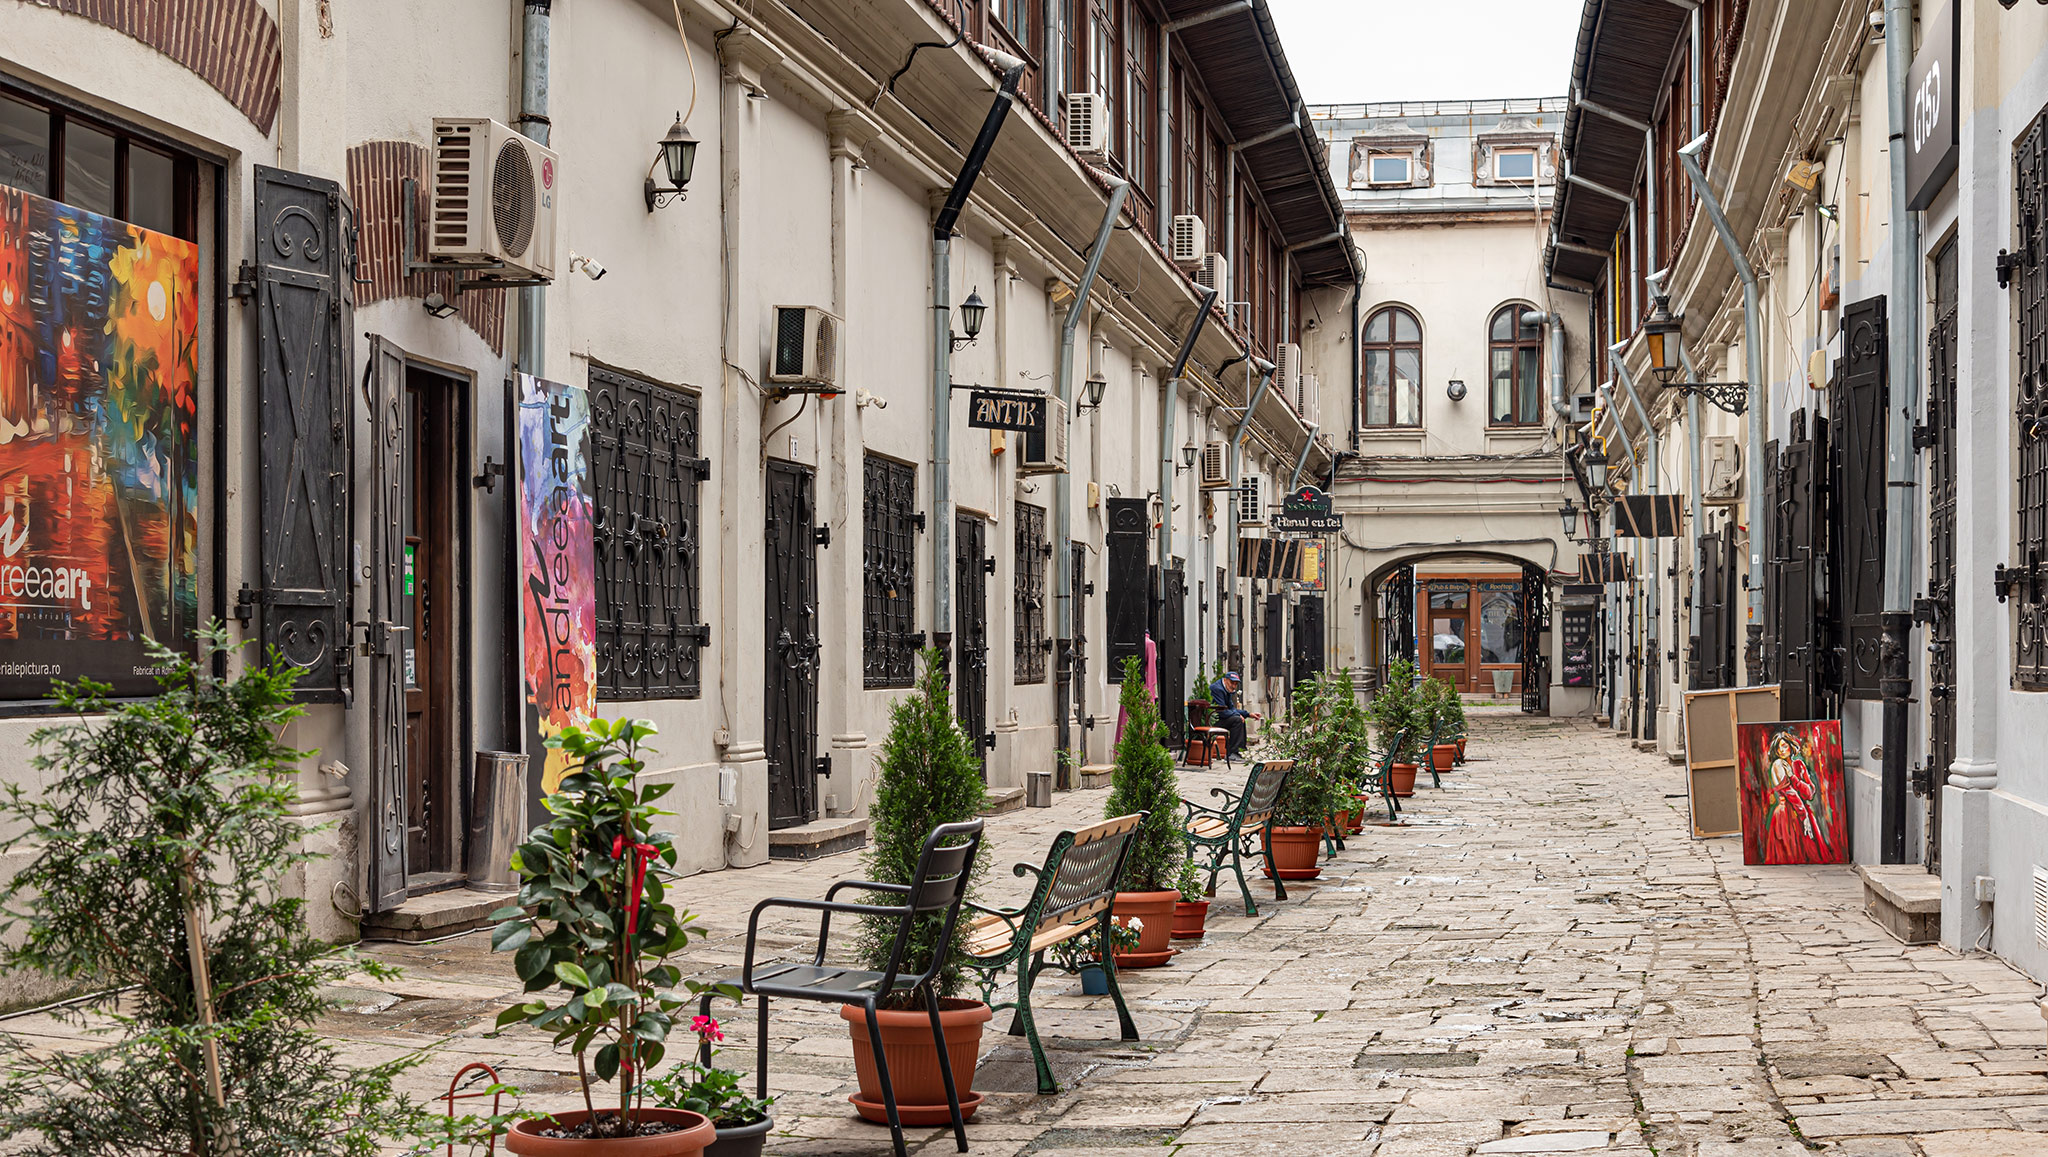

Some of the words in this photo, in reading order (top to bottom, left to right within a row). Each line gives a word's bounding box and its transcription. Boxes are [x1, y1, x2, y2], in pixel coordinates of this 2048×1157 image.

[541, 192, 551, 209] LG
[976, 397, 1036, 427] ANTIK
[1311, 519, 1325, 527] cu
[545, 394, 571, 712] andreeaart
[1489, 583, 1514, 591] Rooftop
[133, 666, 154, 676] Fabricat
